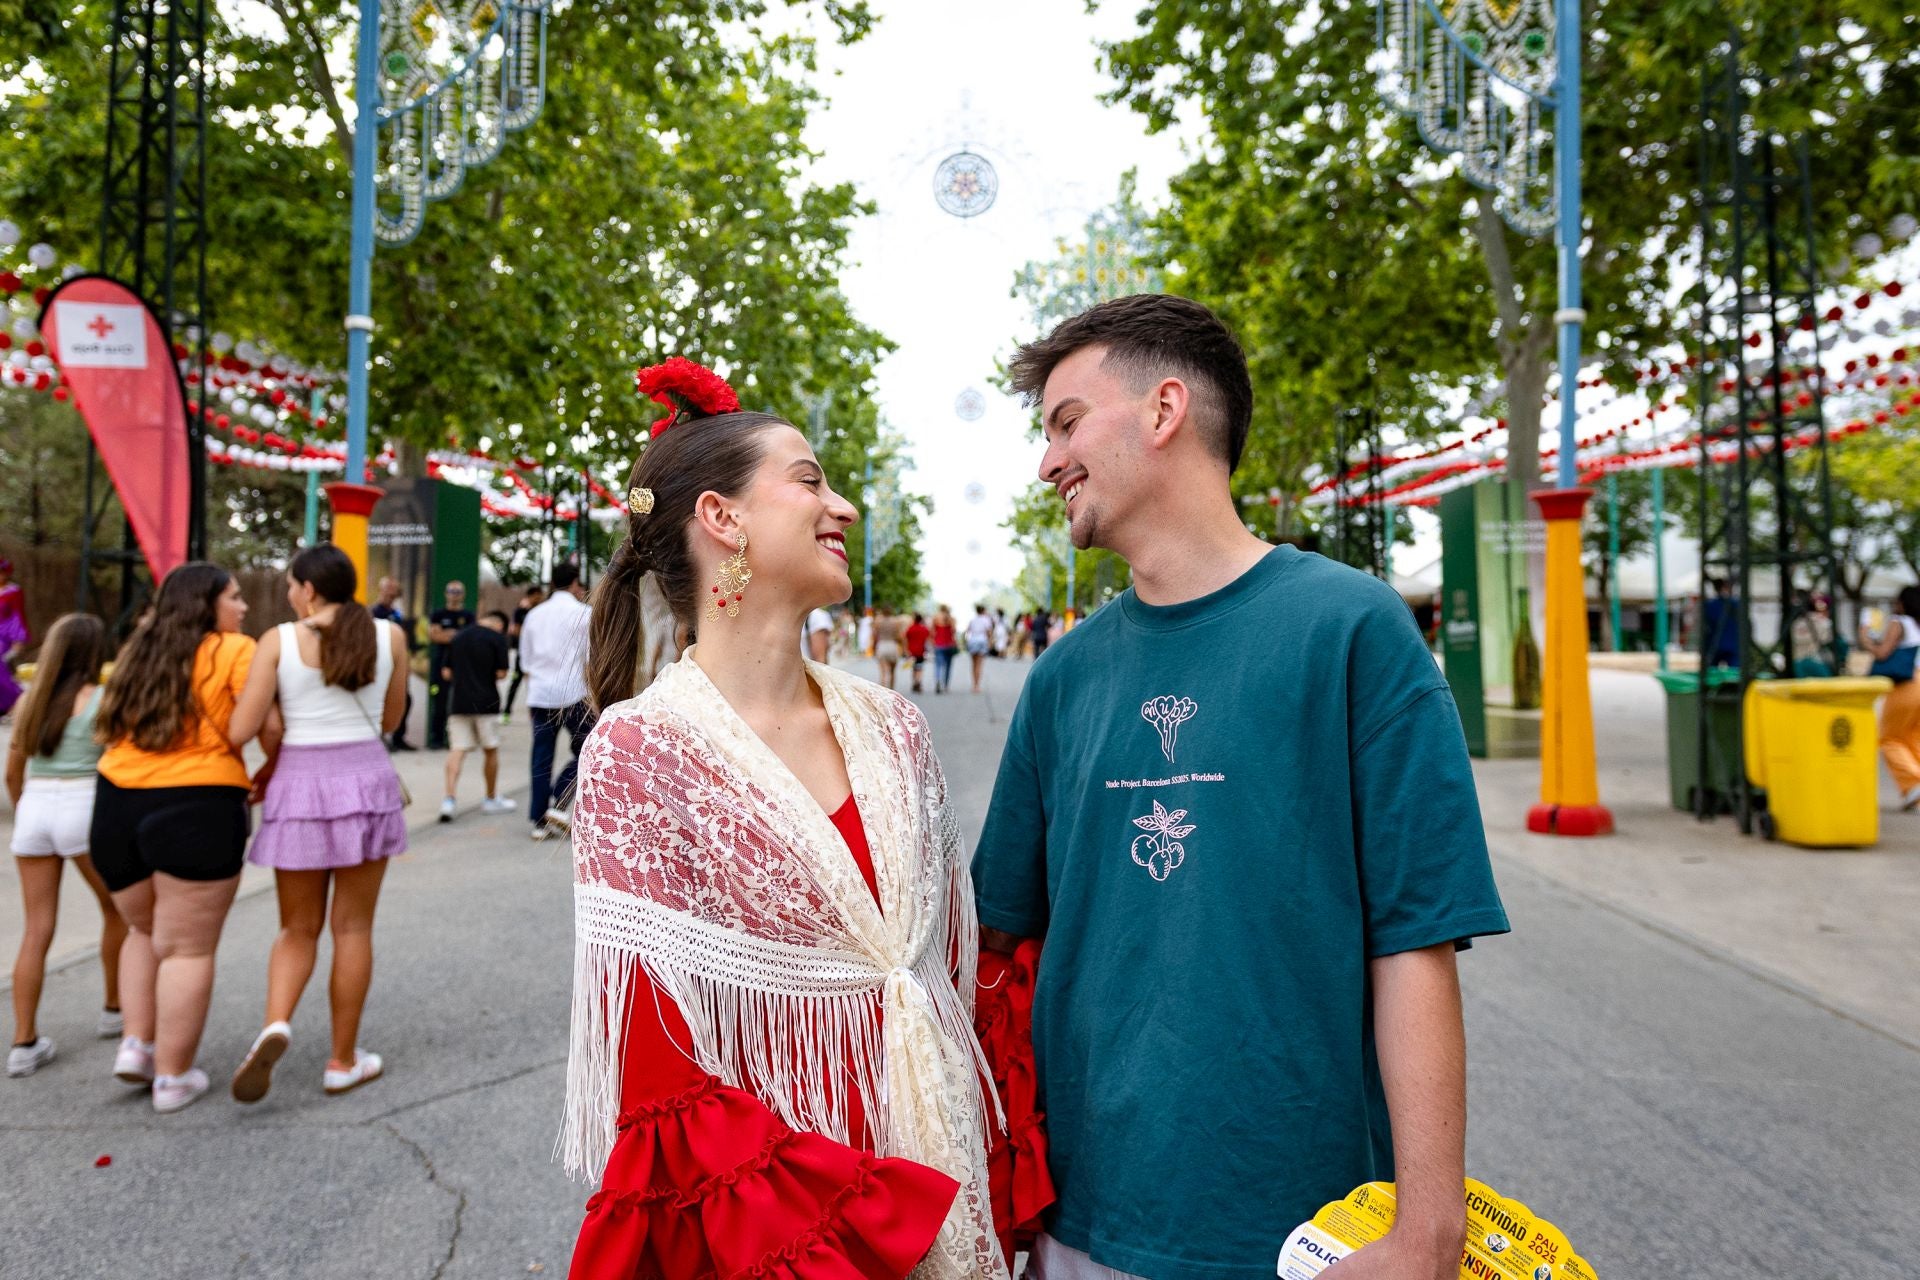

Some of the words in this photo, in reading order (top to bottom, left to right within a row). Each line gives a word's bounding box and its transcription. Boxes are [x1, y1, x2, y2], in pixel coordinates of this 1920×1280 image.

[1105, 780, 1120, 789] Nude
[1142, 778, 1170, 787] Barcelona
[1190, 772, 1225, 782] Worldwide
[1367, 1204, 1387, 1220] REAL
[1464, 1189, 1527, 1241] ECTIVIDAD
[1478, 1189, 1519, 1220] INTENSIVO
[1519, 1217, 1532, 1229] DE
[1296, 1236, 1340, 1265] POLIC
[1528, 1240, 1557, 1265] 2025
[1535, 1232, 1559, 1253] PAU
